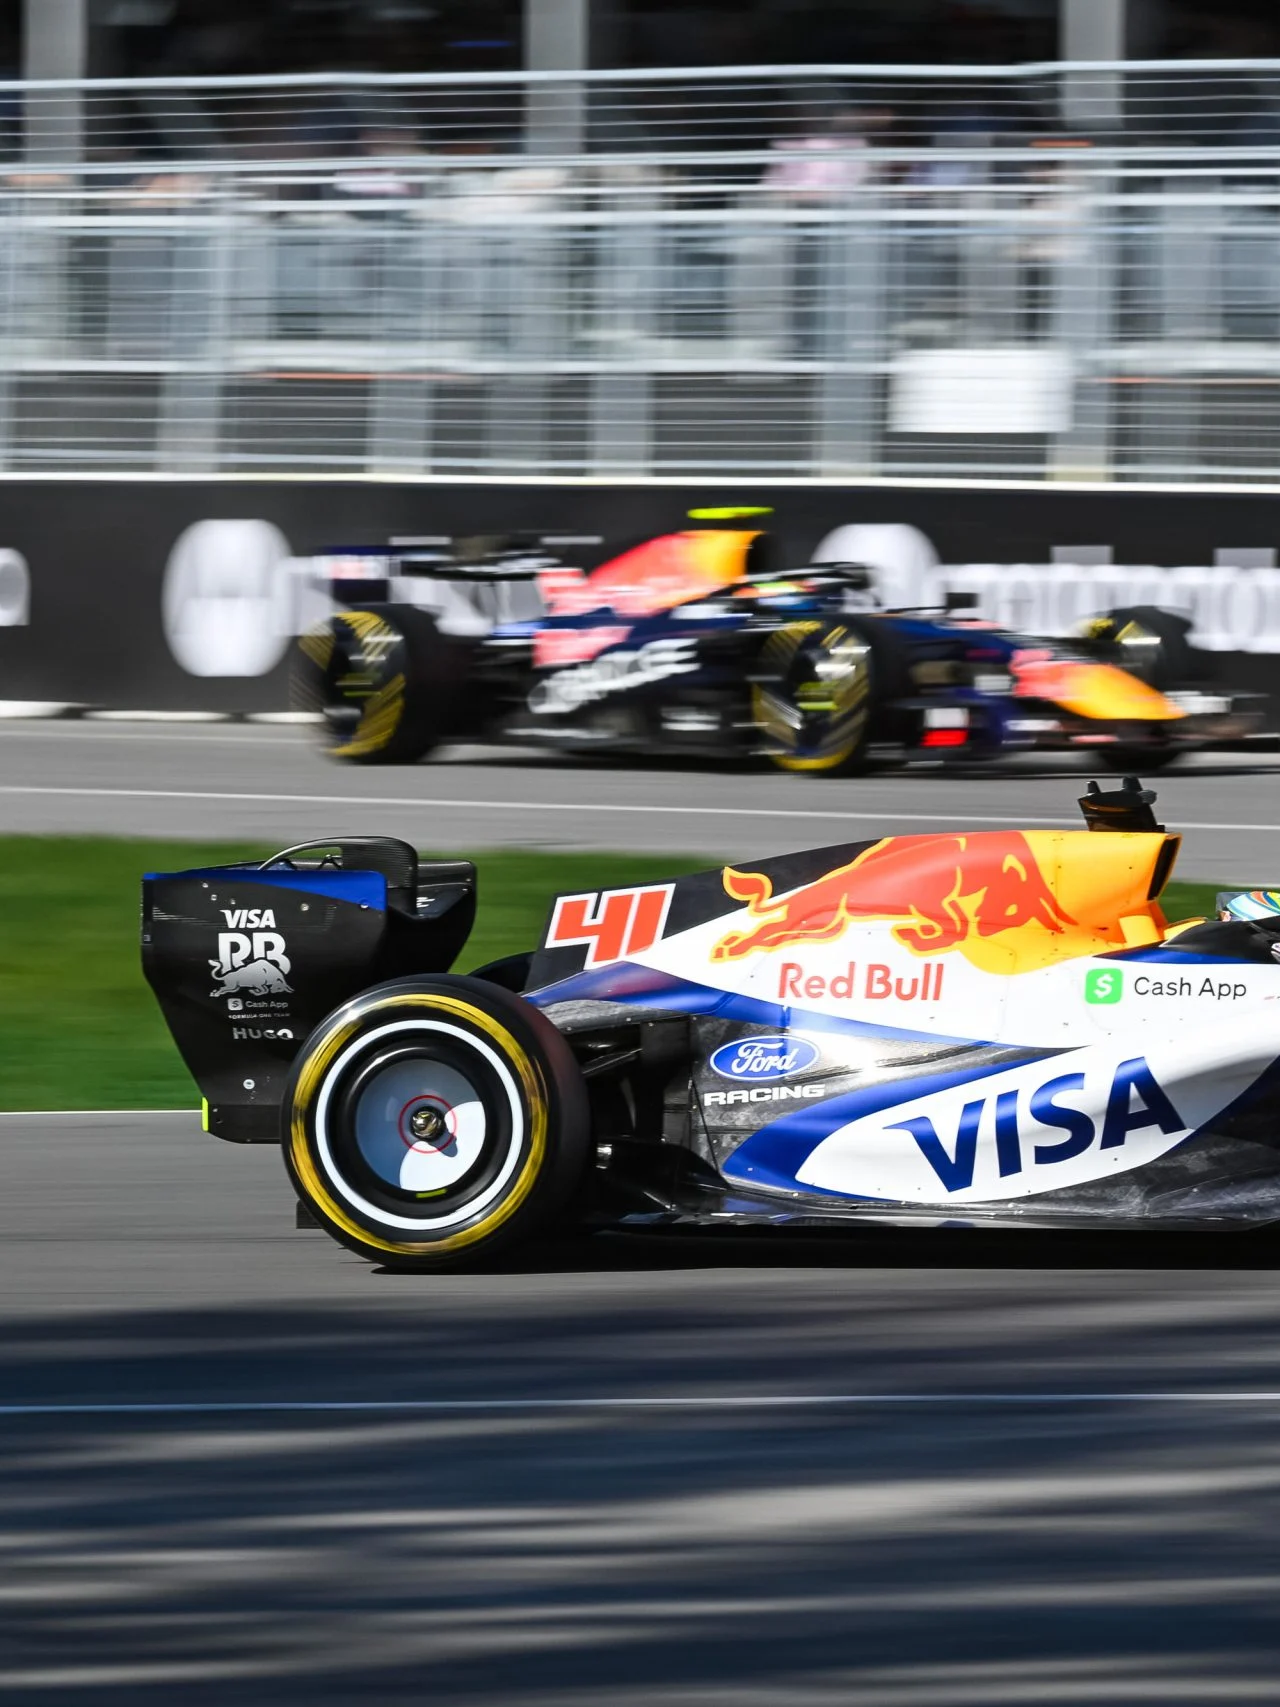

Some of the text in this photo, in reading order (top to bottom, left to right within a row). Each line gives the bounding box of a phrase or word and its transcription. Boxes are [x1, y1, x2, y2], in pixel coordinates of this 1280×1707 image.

[219, 909, 276, 928] VISA
[547, 884, 674, 966] 41
[778, 962, 944, 1001] Red Bull
[1134, 976, 1192, 996] Cash
[1198, 977, 1247, 1000] App
[270, 1001, 288, 1009] App
[232, 1027, 294, 1040] HUGO
[731, 1042, 799, 1074] Ford
[704, 1084, 826, 1106] RACING
[883, 1056, 1187, 1193] VISA
